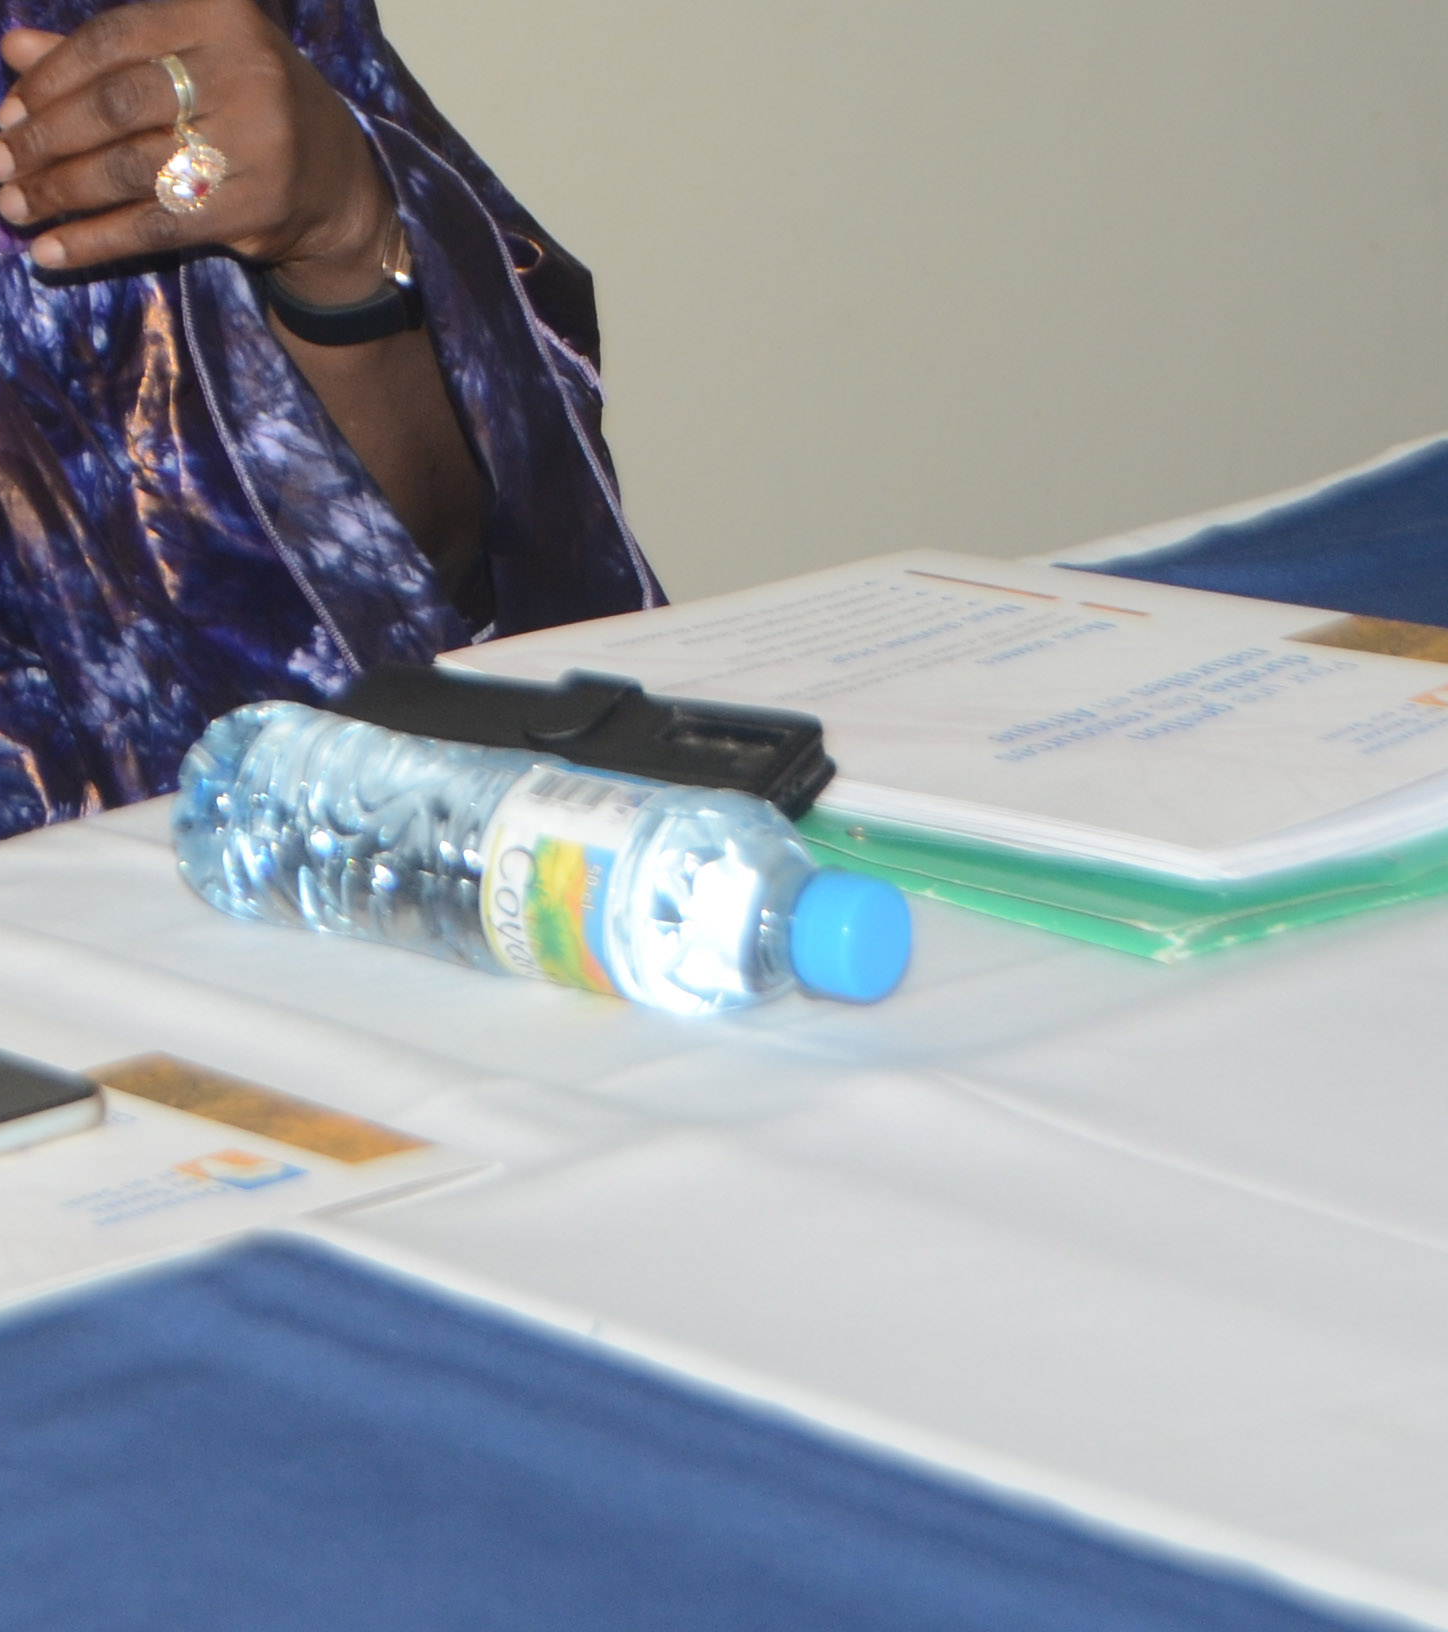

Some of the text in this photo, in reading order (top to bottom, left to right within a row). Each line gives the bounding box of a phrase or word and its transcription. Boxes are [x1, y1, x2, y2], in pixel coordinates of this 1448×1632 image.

[988, 645, 1272, 745] naturelles en Afrique
[994, 651, 1311, 763] durable des ressources
[1124, 659, 1359, 742] Pour une gestion
